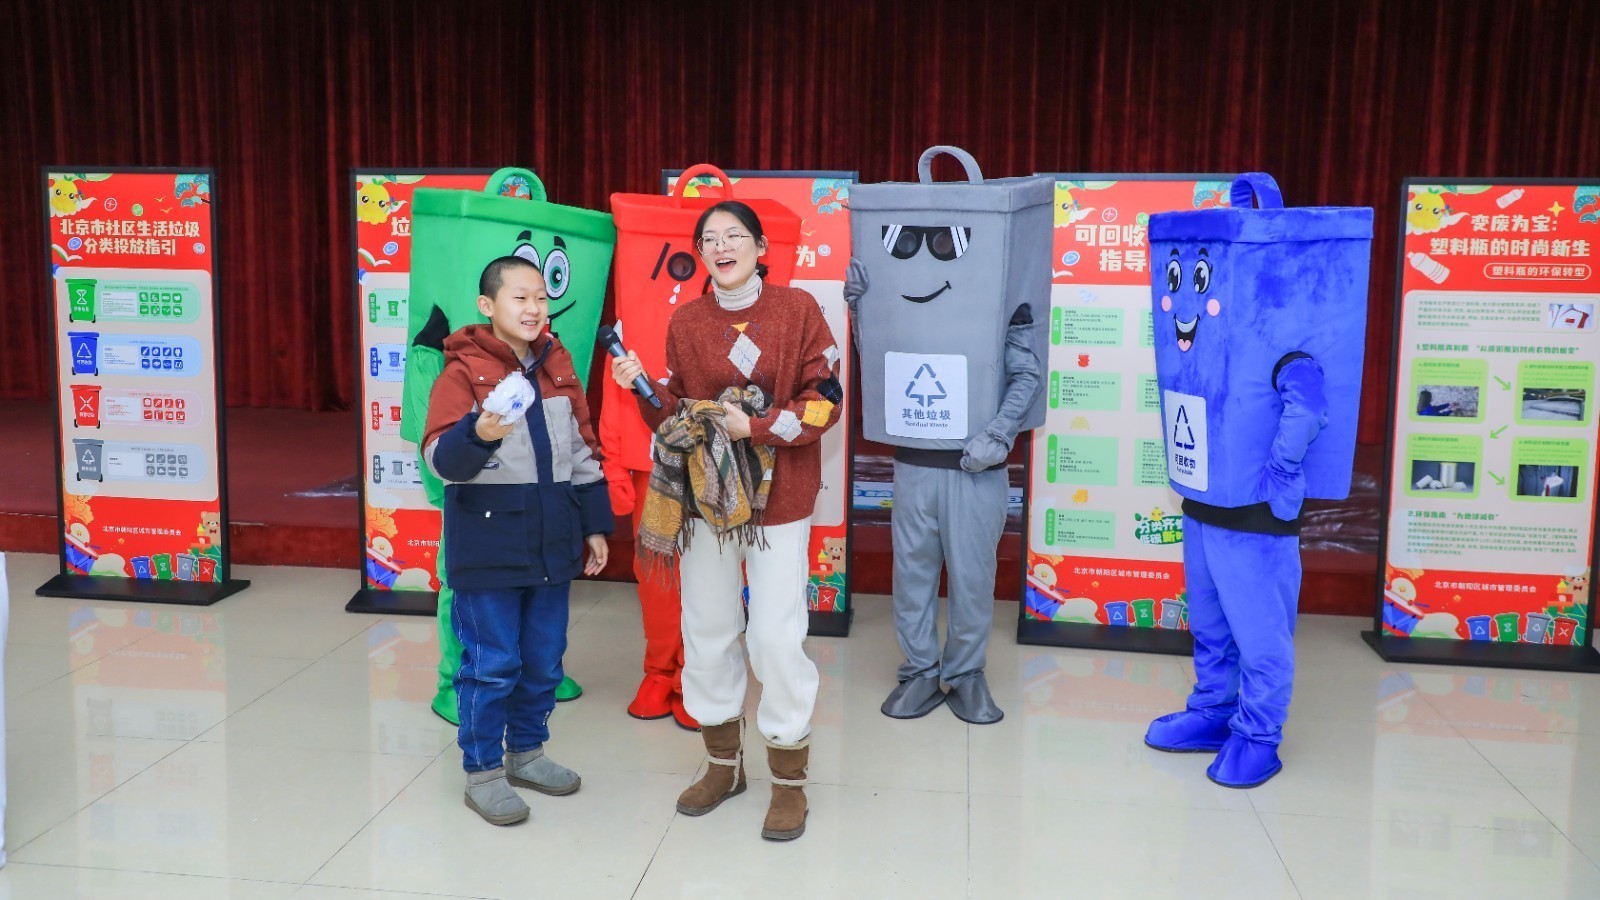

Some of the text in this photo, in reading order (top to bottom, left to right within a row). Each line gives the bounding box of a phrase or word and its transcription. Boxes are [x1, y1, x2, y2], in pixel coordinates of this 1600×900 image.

[60, 218, 200, 238] 北京市社区生活垃圾
[390, 216, 411, 237] 垃
[1470, 214, 1557, 233] 变废为宝：
[1074, 224, 1147, 247] 可回收
[83, 237, 177, 256] 分类投放指引
[1430, 237, 1591, 257] 塑料瓶的时尚新生
[795, 245, 816, 268] 为
[1099, 249, 1151, 272] 指导
[1491, 265, 1586, 277] 塑料瓶的环保转型
[901, 408, 951, 420] 其他垃圾
[1073, 566, 1171, 580] 北京市朝阳区城市管理委员会
[1433, 580, 1537, 593] 北京市朝阳区城市管理委员会
